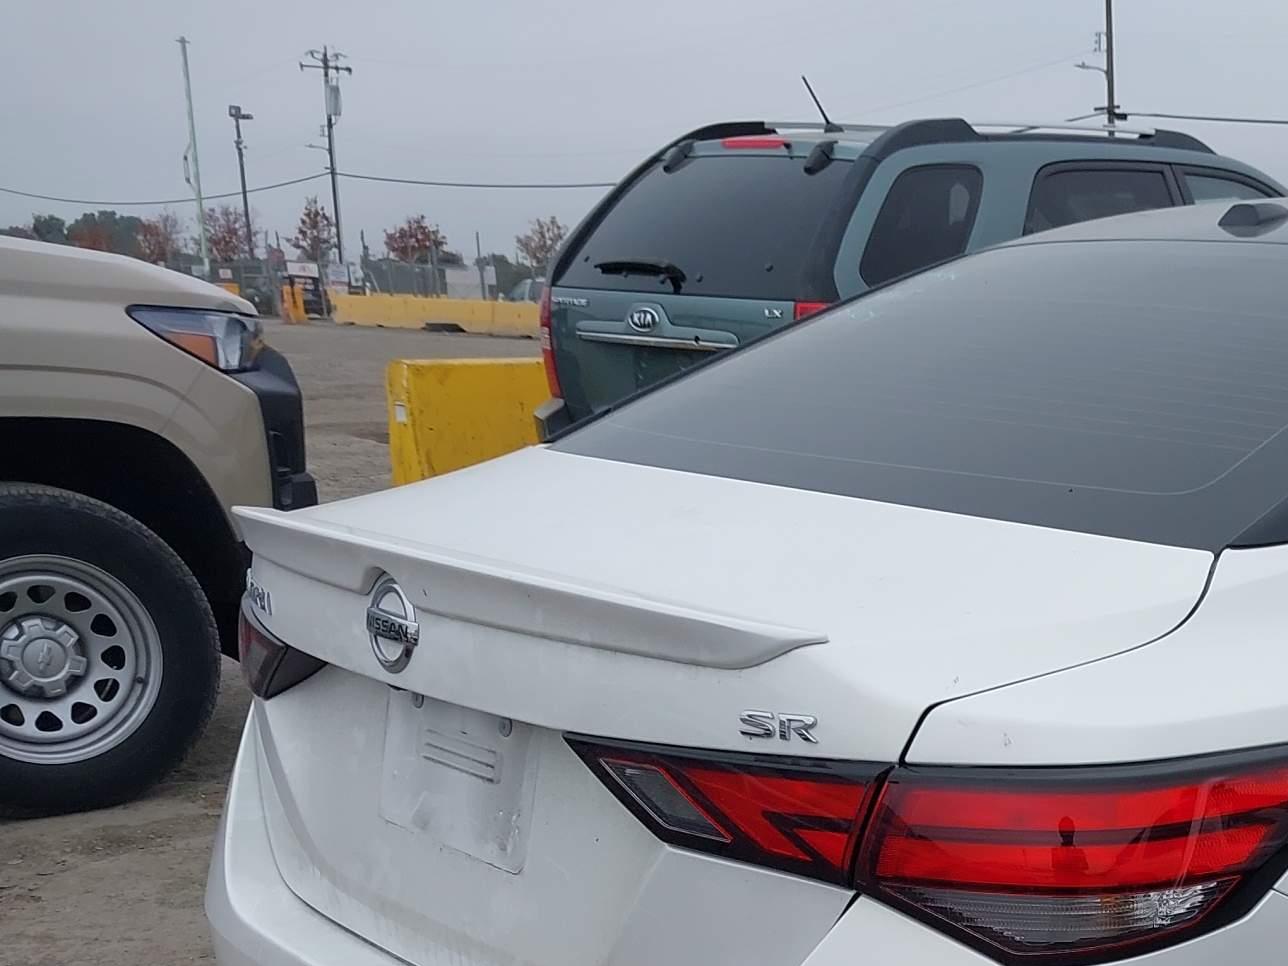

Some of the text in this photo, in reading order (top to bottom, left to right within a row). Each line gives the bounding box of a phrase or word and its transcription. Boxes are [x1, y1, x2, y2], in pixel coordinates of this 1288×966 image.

[630, 311, 654, 328] KIA
[764, 308, 782, 318] LX
[366, 612, 409, 643] NISSAN
[739, 709, 819, 744] SR
